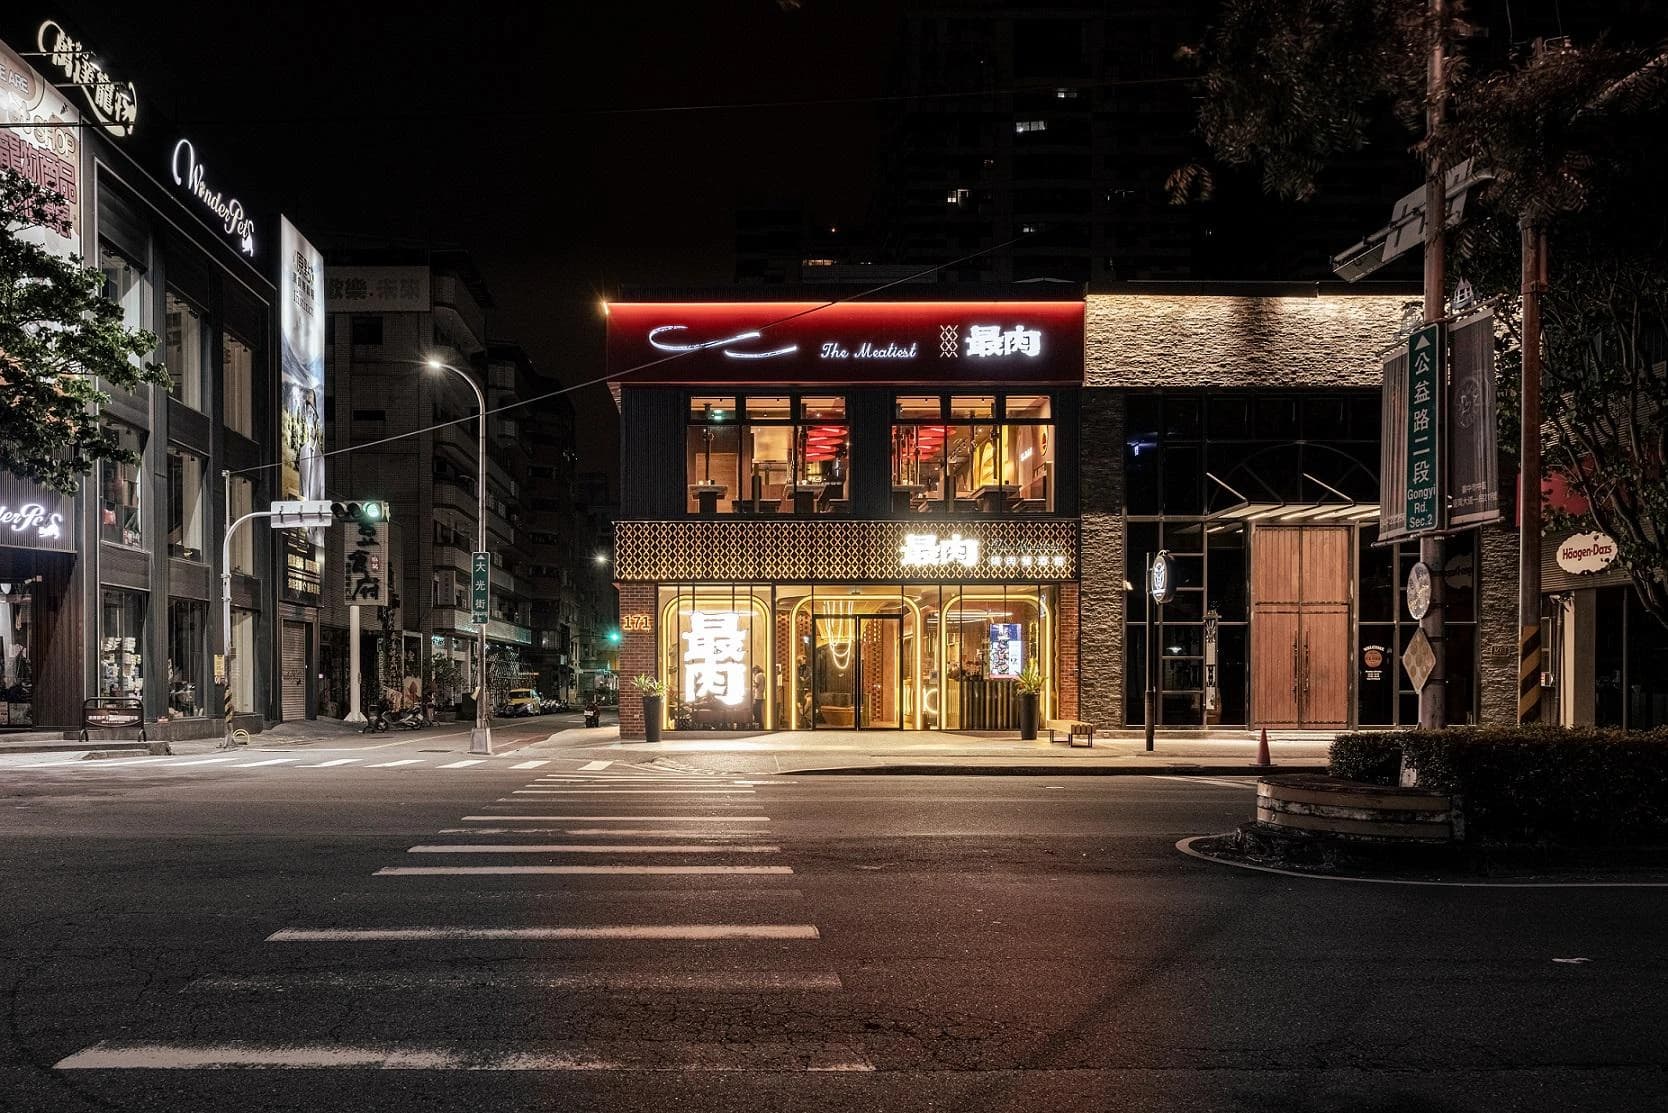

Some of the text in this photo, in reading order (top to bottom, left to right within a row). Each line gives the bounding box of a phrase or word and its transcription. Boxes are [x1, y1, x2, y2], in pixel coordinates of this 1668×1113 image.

[821, 341, 917, 358] The Meatiest
[965, 324, 1042, 358] 最肉
[1413, 351, 1431, 485] 公益路二段
[1407, 483, 1437, 500] Gongyi
[1414, 502, 1428, 514] Rd.
[1408, 514, 1433, 529] Sec.2
[900, 532, 979, 568] 最肉
[475, 561, 486, 609] 大光街
[622, 614, 652, 631] 171
[682, 611, 747, 705] 最肉
